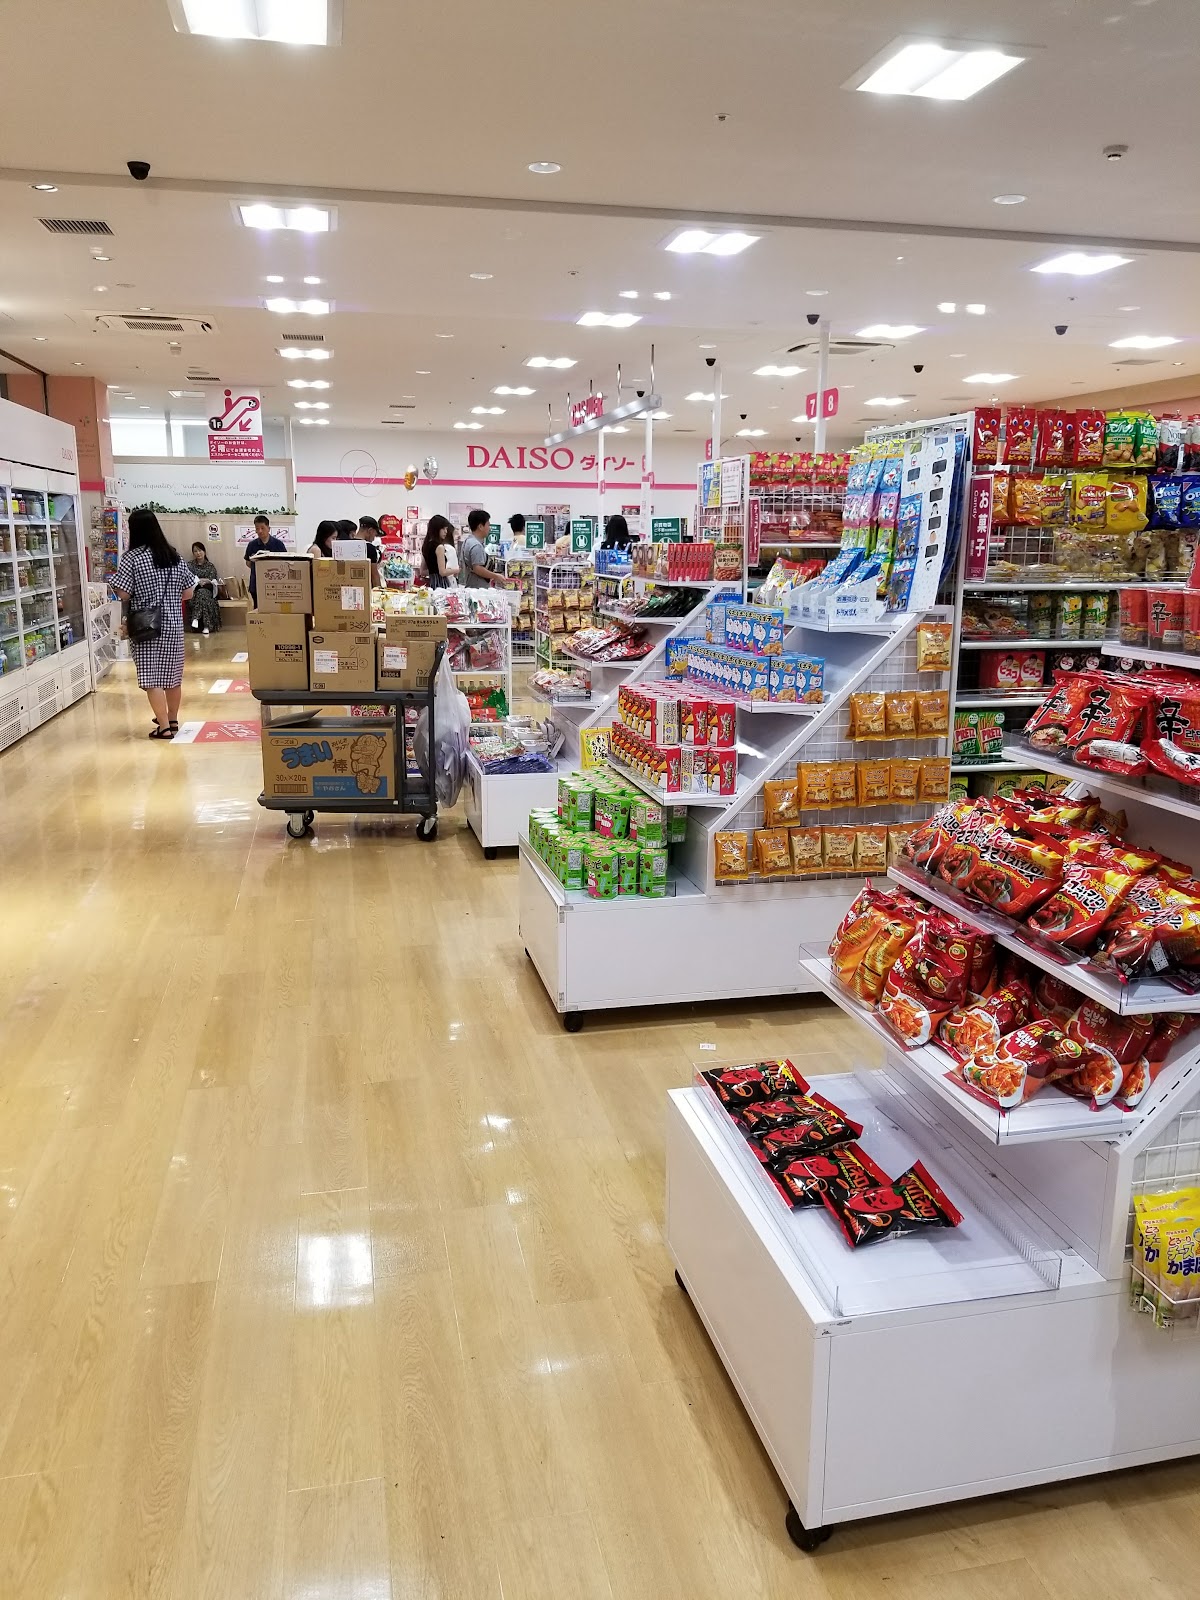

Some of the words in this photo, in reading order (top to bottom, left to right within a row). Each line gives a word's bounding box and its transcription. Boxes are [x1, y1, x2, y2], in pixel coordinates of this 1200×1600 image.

[810, 399, 815, 415] 7
[828, 395, 834, 411] 8
[211, 419, 222, 428] 1F
[467, 445, 574, 470] DAISO
[580, 455, 635, 470] ダイソー
[1155, 489, 1181, 498] OREO
[975, 490, 989, 557] お菓子
[1150, 600, 1172, 633] 辛
[999, 665, 1018, 680] ビスコ
[1022, 665, 1042, 679] ビスコ
[1077, 685, 1112, 741] 辛
[1156, 696, 1190, 742] 辛
[956, 728, 975, 742] PRETZ
[982, 728, 1002, 742] PRETZ
[281, 740, 333, 769] うまい
[332, 759, 348, 774] 棒
[1013, 1029, 1039, 1049] 떡볶이
[1167, 1242, 1195, 1261] チーズ
